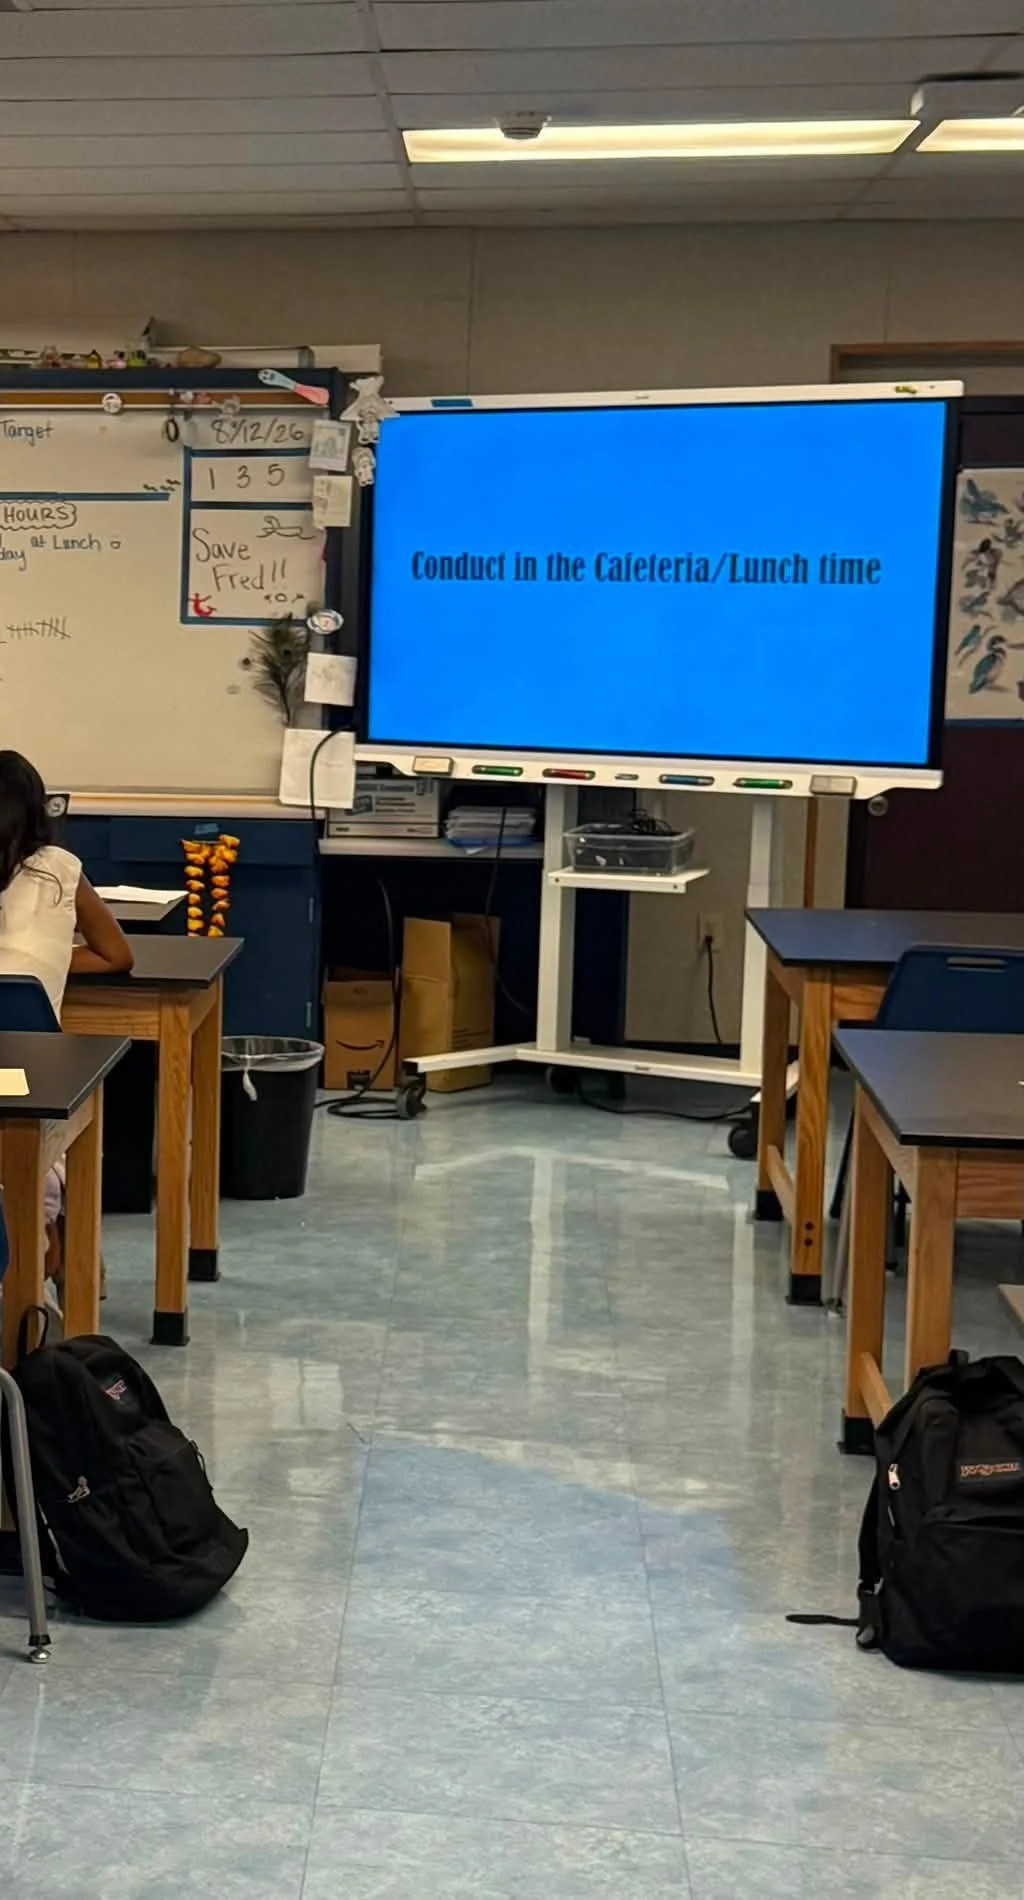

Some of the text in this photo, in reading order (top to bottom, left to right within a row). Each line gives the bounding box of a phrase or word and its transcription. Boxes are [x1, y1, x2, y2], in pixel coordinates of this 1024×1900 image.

[208, 463, 286, 491] 1 3 5
[4, 505, 70, 523] HOURS
[31, 533, 102, 551] at Lunch
[192, 527, 251, 562] Save
[212, 558, 287, 592] Fred!!
[411, 551, 881, 586] Conduct in the Cafeteria/Lunch time
